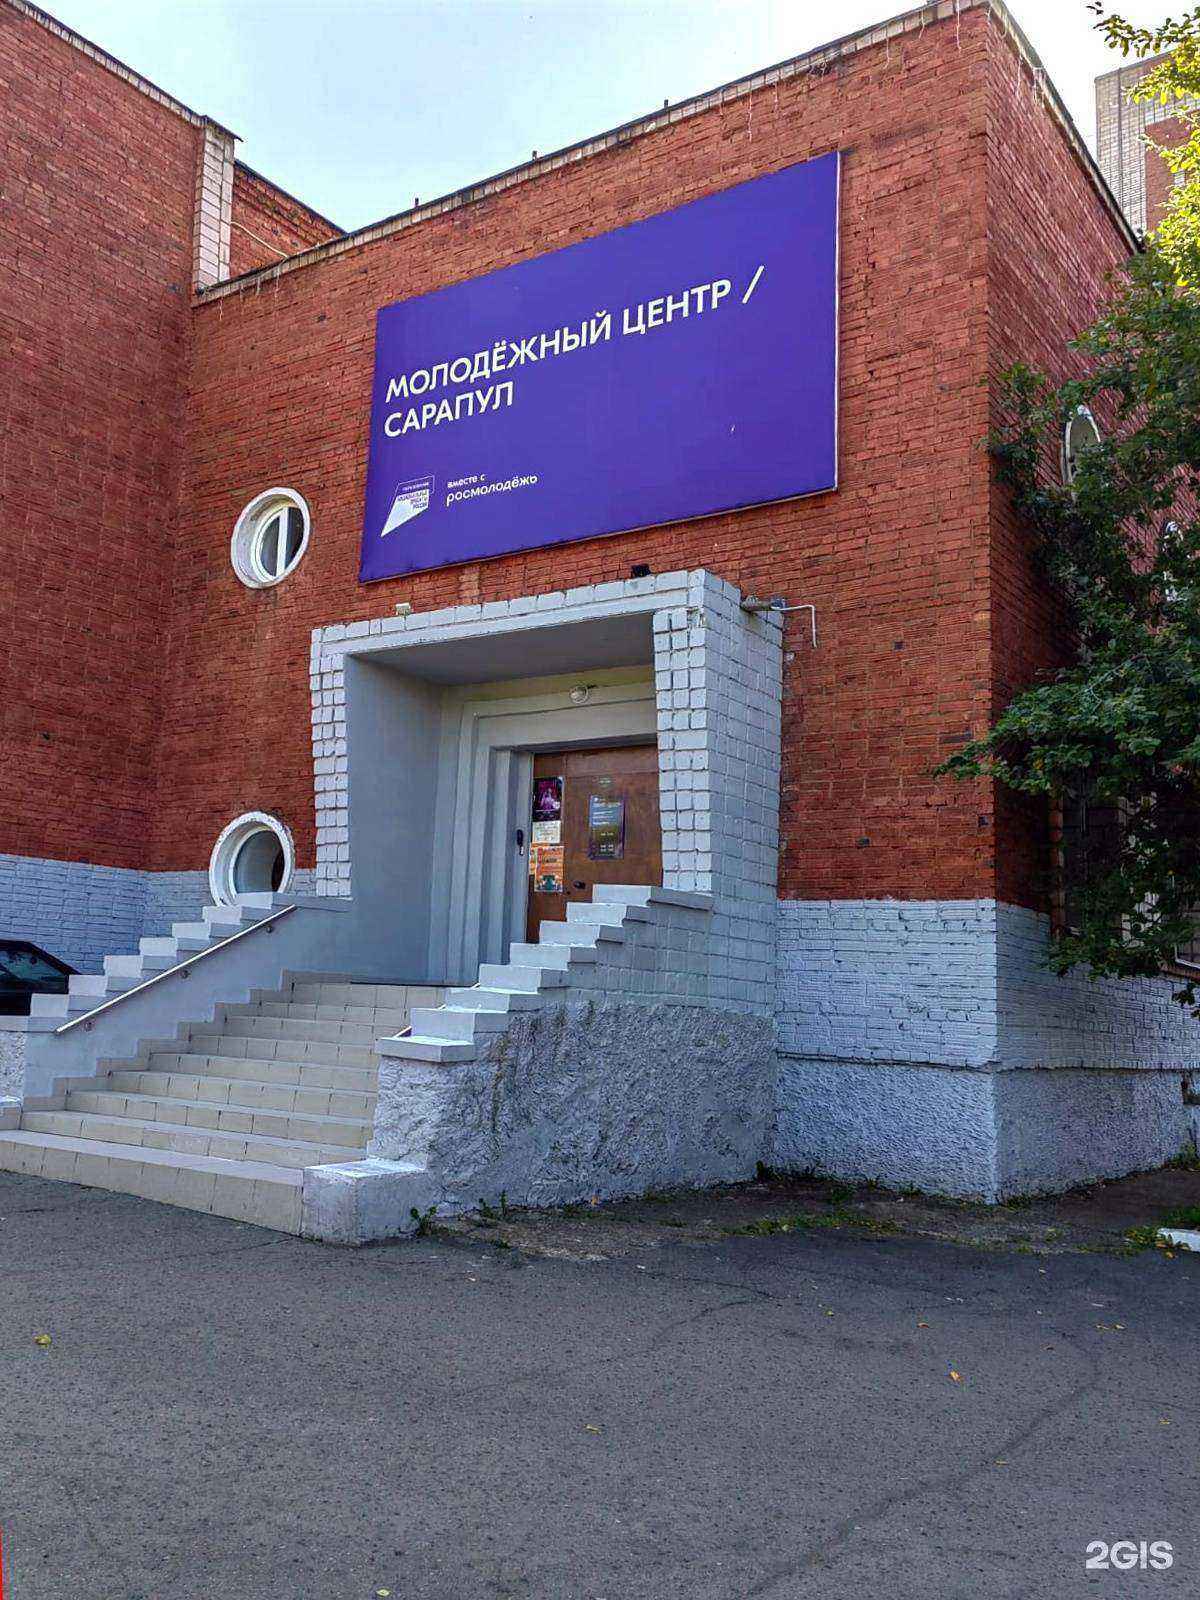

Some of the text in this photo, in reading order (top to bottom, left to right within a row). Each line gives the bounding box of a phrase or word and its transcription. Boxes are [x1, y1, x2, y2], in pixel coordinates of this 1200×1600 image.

[385, 309, 612, 403] МОЛОДЁЖНЫЙ
[622, 279, 732, 335] ЦЕНТР
[384, 381, 514, 437] САРАПУЛ
[446, 473, 538, 507] росмолодёжь
[447, 475, 478, 489] вместе
